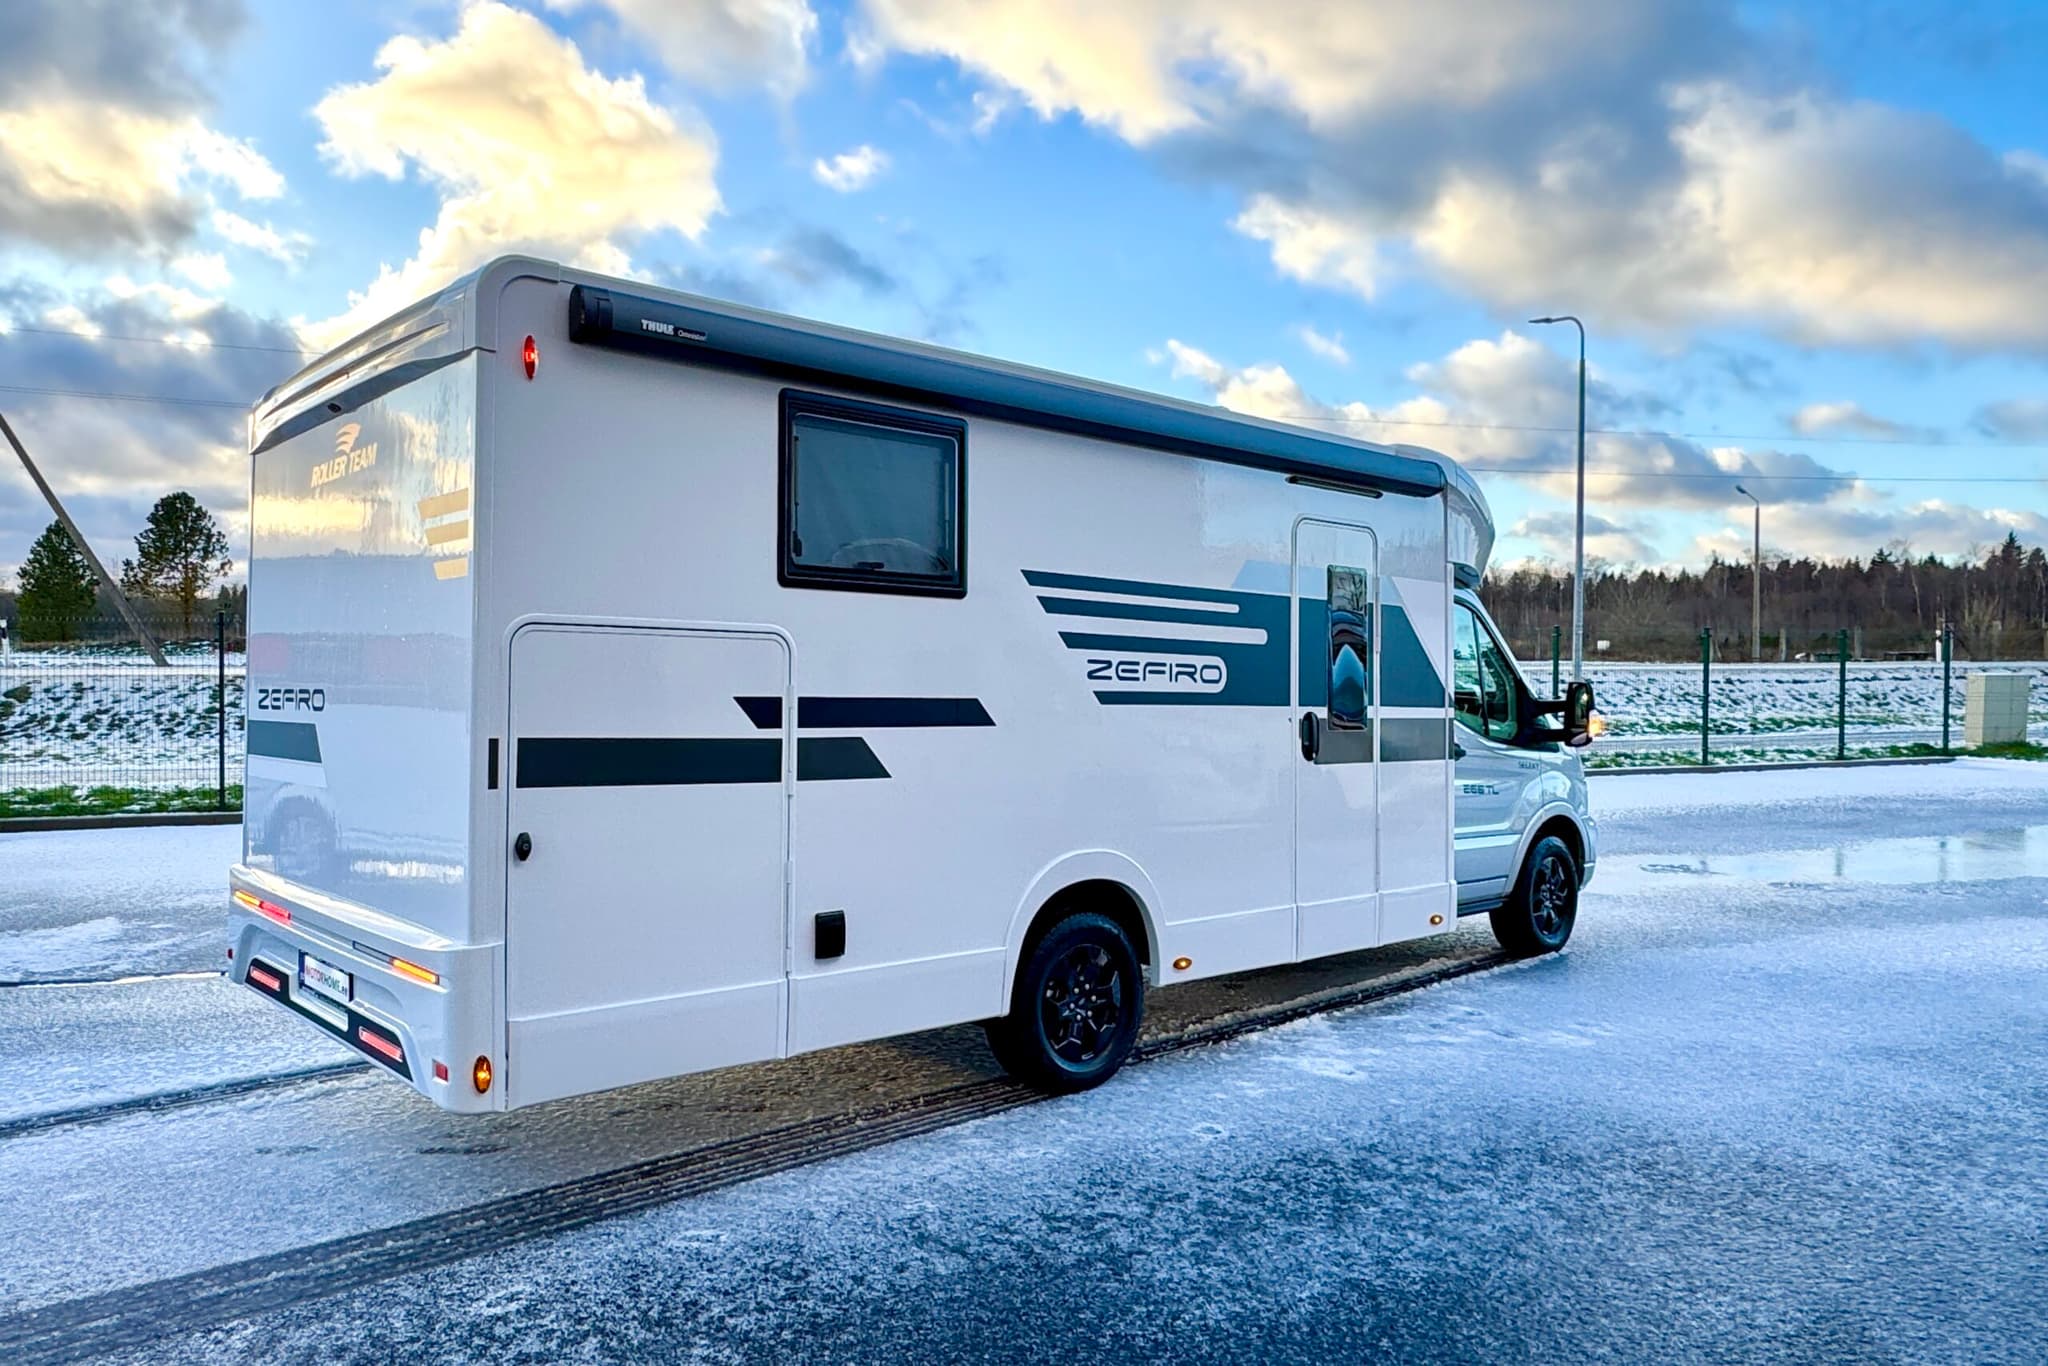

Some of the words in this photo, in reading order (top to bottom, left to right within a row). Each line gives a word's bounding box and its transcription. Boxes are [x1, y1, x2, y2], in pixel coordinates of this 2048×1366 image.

[641, 319, 674, 336] THULE
[310, 455, 347, 488] ROLLER
[349, 442, 378, 475] TEAM
[1087, 659, 1222, 684] ZEFIRO
[258, 688, 325, 711] ZEFIRO
